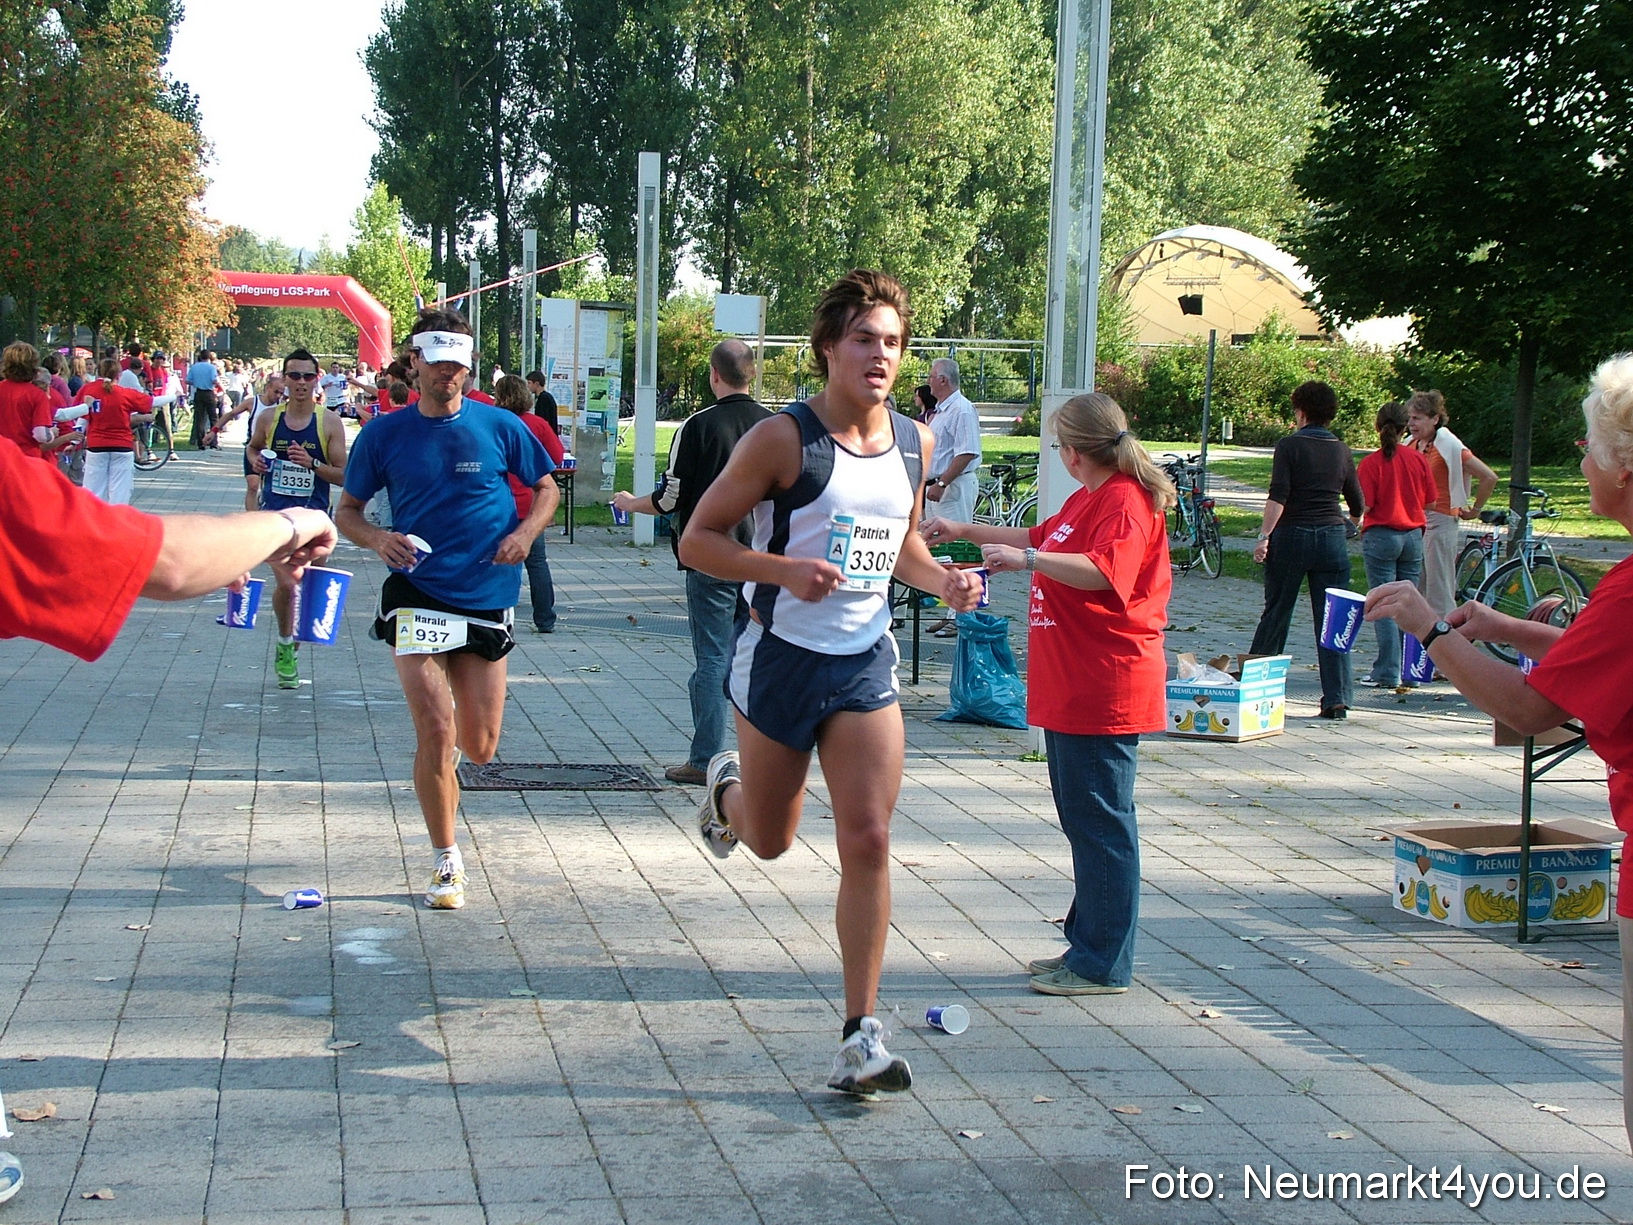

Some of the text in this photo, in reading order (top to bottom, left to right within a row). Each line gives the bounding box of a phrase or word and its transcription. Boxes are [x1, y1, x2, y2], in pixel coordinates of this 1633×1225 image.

[218, 283, 331, 297] Verpflegung LGS-Park
[282, 464, 308, 475] Andreas
[282, 475, 311, 488] 3335
[853, 525, 890, 541] Patrick
[832, 543, 843, 556] A
[414, 614, 447, 627] Harald
[1333, 604, 1359, 650] Xenofit
[400, 625, 451, 643] A 937
[1170, 686, 1200, 696] PREMIUM
[1203, 688, 1236, 698] BANANAS
[1476, 853, 1598, 871] PREMIU BANANAS
